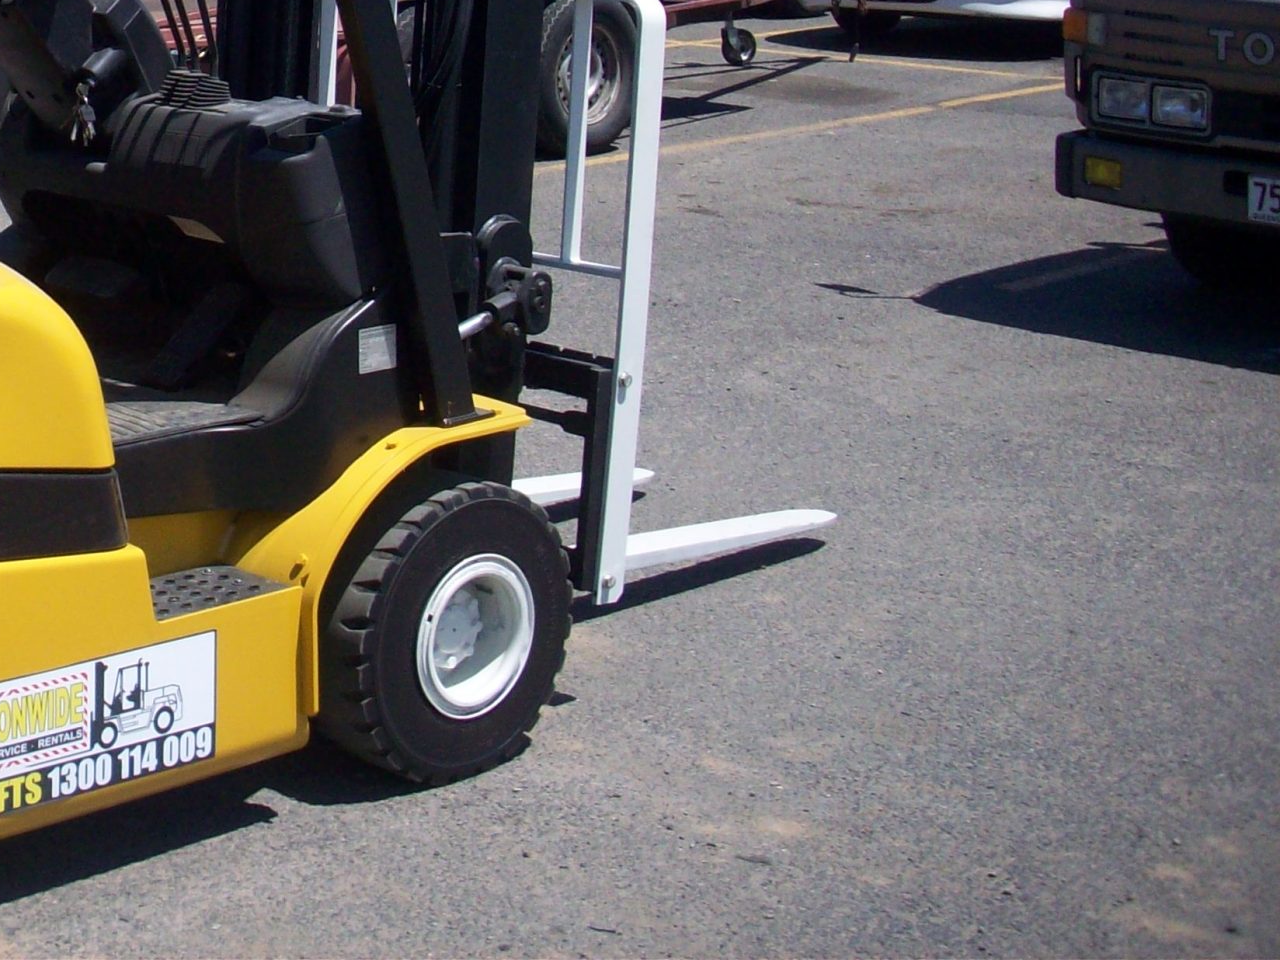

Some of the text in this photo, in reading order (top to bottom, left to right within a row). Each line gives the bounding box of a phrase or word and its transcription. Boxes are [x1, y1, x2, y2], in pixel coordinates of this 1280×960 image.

[37, 728, 83, 748] RENTALS
[47, 753, 112, 798] 1300
[118, 741, 158, 780] 114
[163, 726, 212, 765] 009
